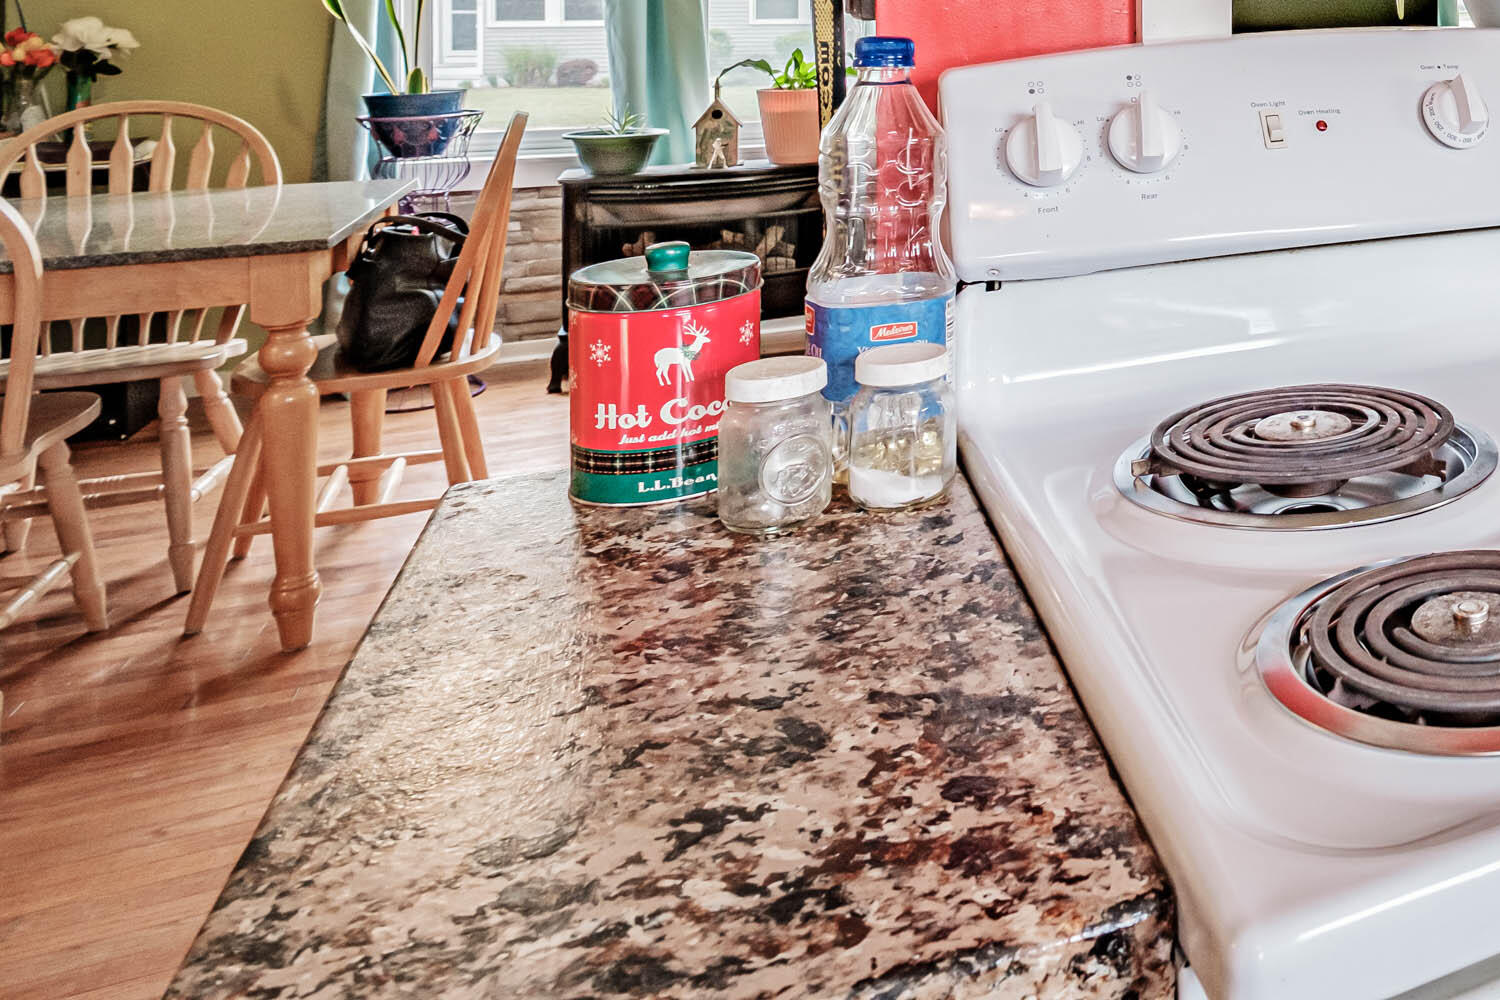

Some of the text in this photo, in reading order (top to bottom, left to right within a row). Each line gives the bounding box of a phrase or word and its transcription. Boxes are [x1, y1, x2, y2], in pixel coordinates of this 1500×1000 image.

[1037, 206, 1059, 214] Front
[594, 397, 732, 430] Hot Coco
[618, 433, 646, 445] Just
[647, 428, 677, 442] add
[679, 424, 702, 438] hot
[638, 472, 718, 493] L.L.Bean
